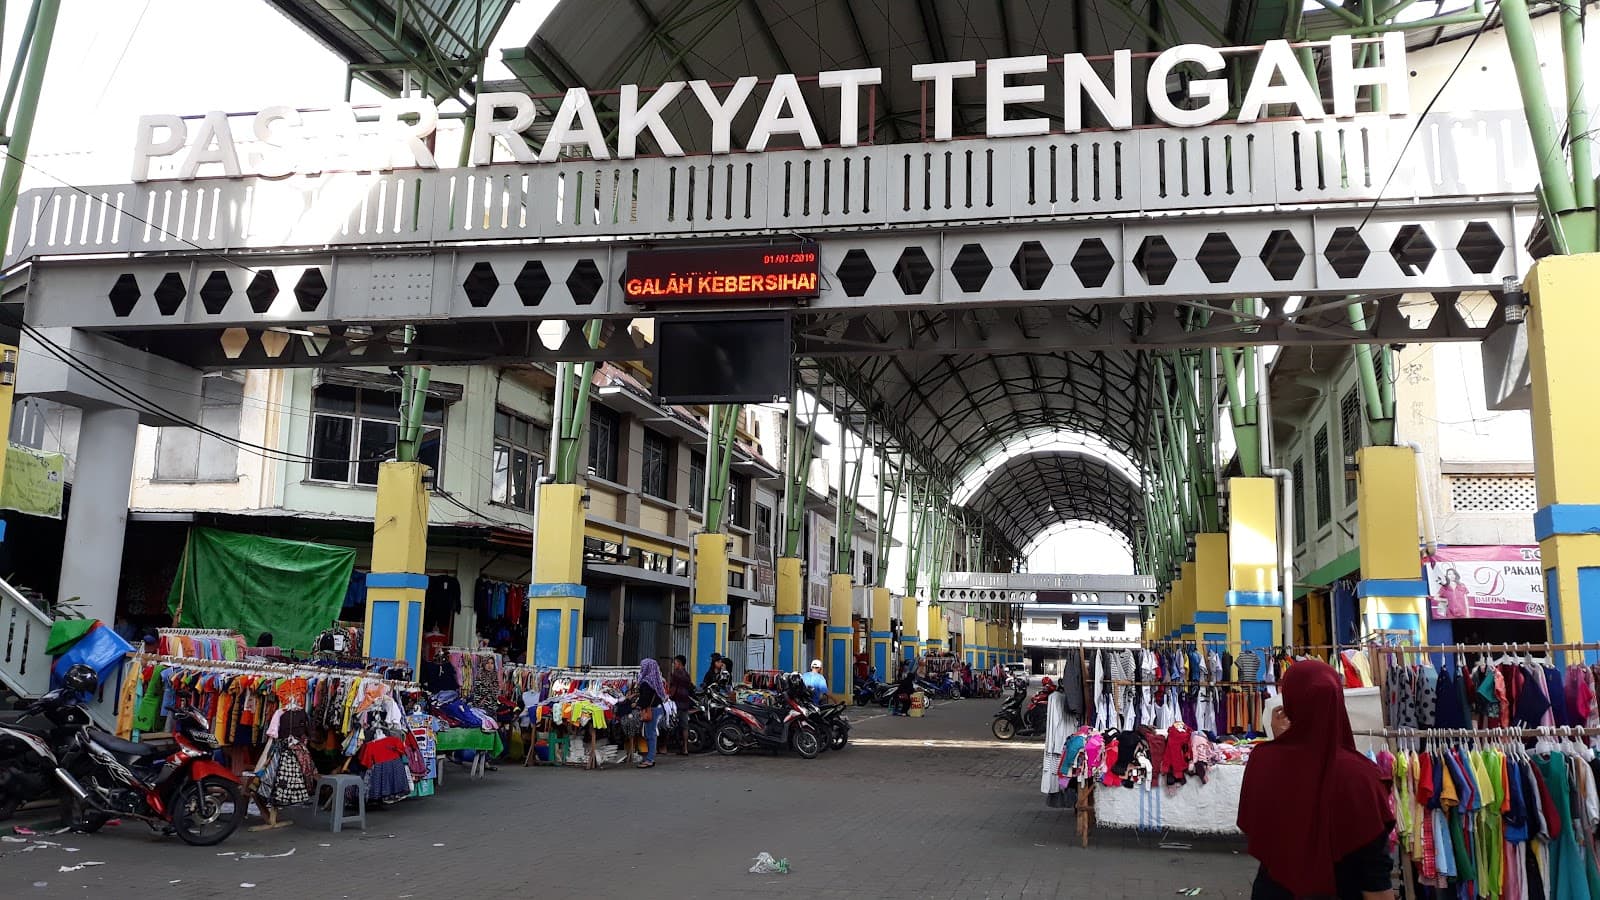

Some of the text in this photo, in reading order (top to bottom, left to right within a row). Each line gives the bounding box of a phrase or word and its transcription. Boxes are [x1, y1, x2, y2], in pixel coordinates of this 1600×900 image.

[131, 31, 1410, 183] PASR RAKYAT TENGAH
[763, 253, 815, 265] 01/01/2019
[627, 273, 692, 296] GALAH
[1504, 565, 1543, 576] PAKAIA
